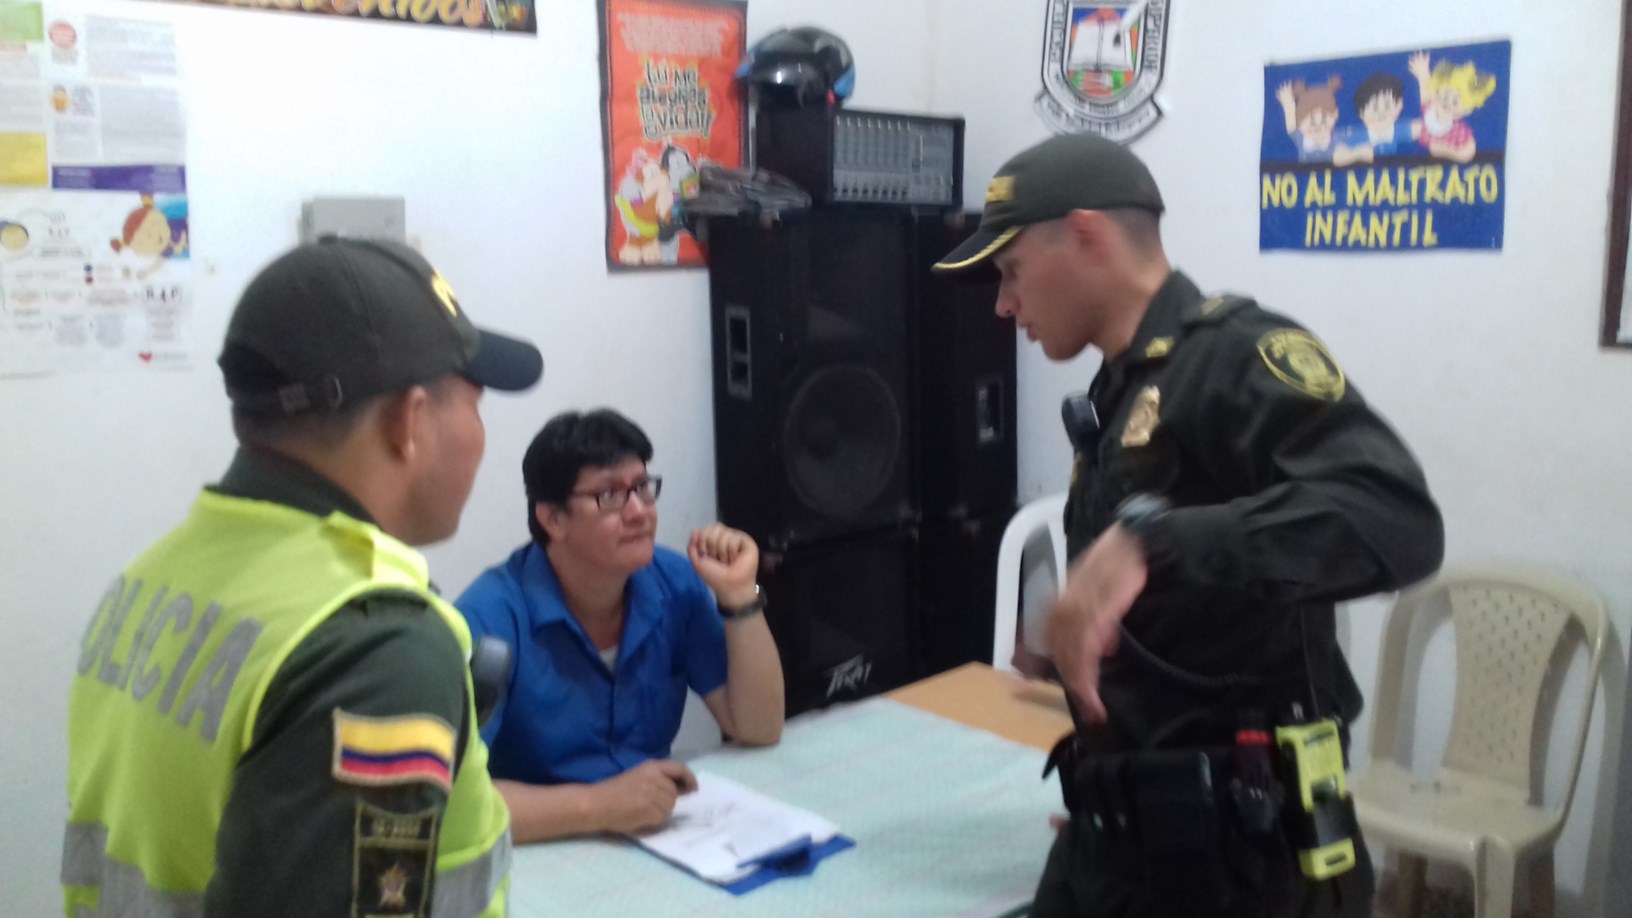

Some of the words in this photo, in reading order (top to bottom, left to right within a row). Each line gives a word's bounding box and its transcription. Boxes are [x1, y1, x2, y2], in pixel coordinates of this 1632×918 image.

[1262, 171, 1298, 209] NO
[1304, 168, 1336, 208] AL
[1347, 164, 1498, 207] MALTRATO
[1305, 208, 1438, 249] INFANTIL
[77, 573, 262, 743] OLICIA
